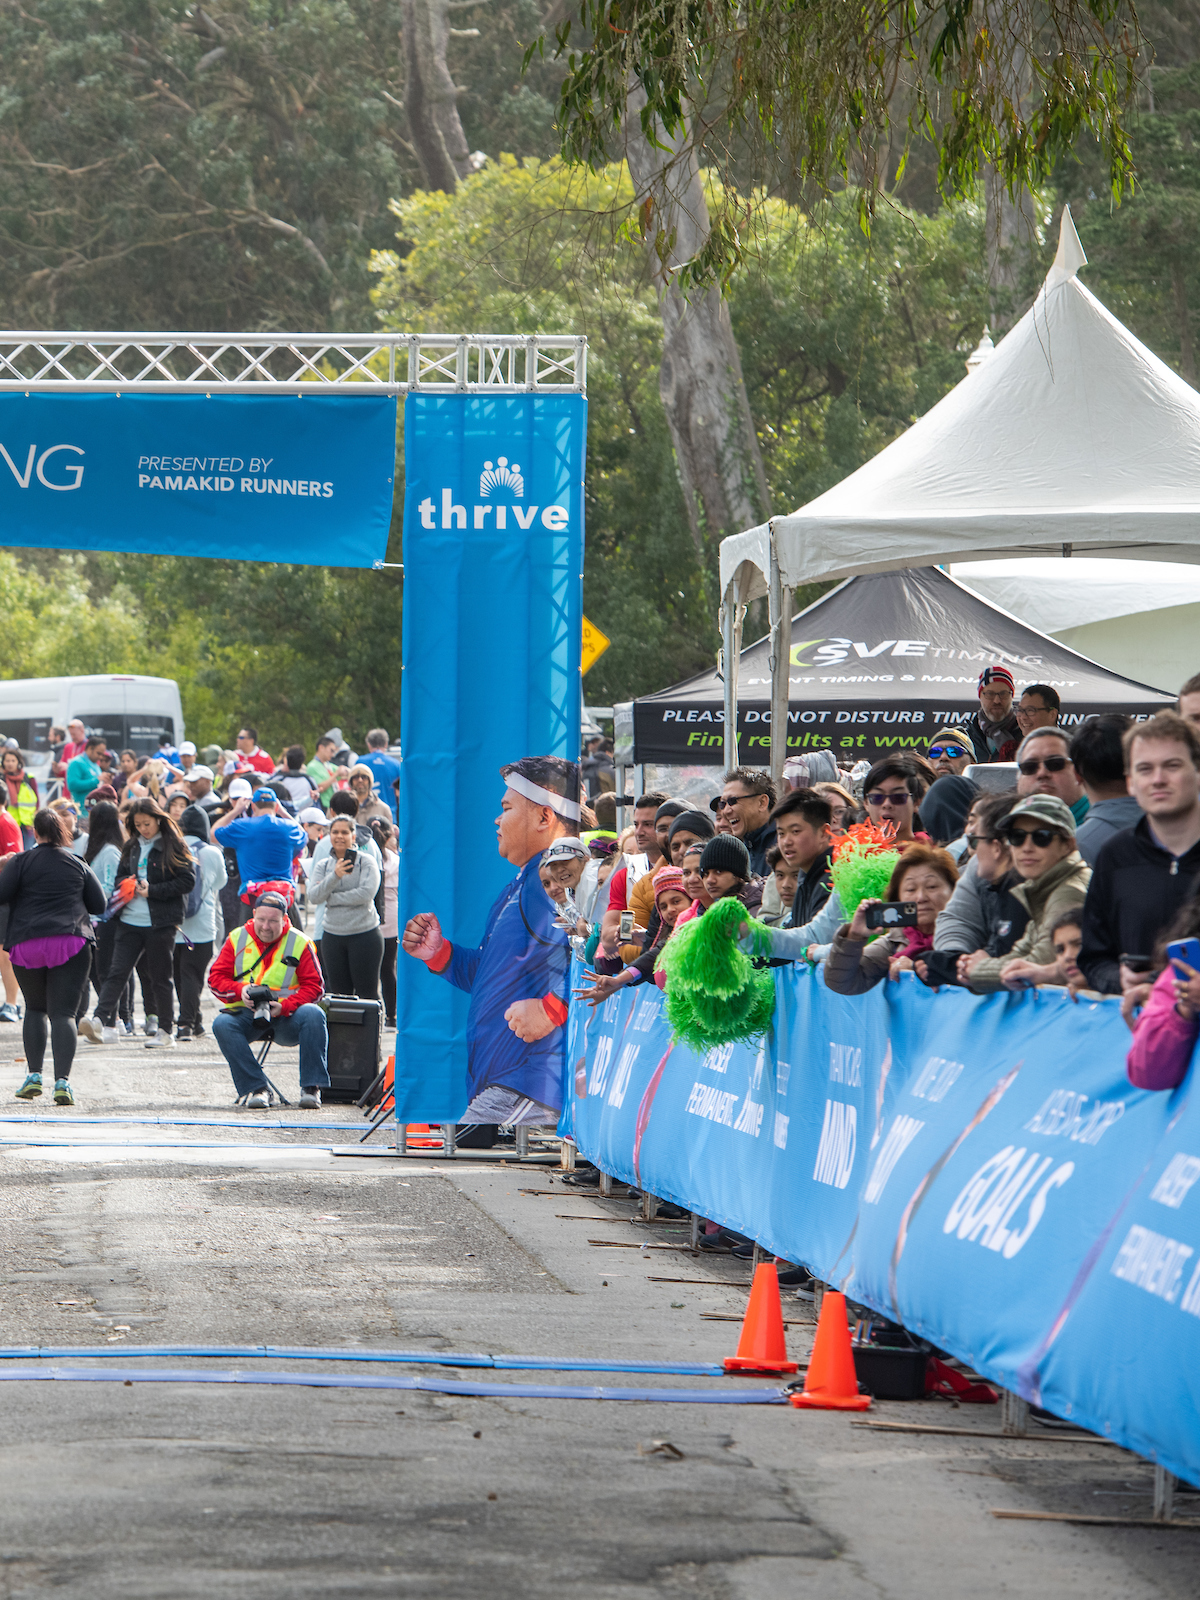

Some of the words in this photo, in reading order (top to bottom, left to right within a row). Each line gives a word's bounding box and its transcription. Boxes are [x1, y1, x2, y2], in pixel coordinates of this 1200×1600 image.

[137, 456, 244, 473] PRESENTED
[249, 457, 274, 473] BY
[138, 474, 235, 492] PAMAKID
[240, 477, 334, 498] RUNNERS
[418, 488, 570, 530] thrive
[812, 639, 931, 661] SVE
[930, 647, 1043, 665] TIMING
[747, 677, 815, 685] EVNT
[819, 674, 894, 683] TIMING
[900, 674, 916, 682] &
[662, 710, 739, 723] PLEAS
[786, 711, 831, 723] NOT
[835, 711, 925, 723] DISTURB
[686, 732, 742, 746] Fin
[748, 732, 832, 747] reults
[839, 733, 866, 747] at
[813, 1098, 857, 1190] MIND
[943, 1144, 1076, 1260] GOALS
